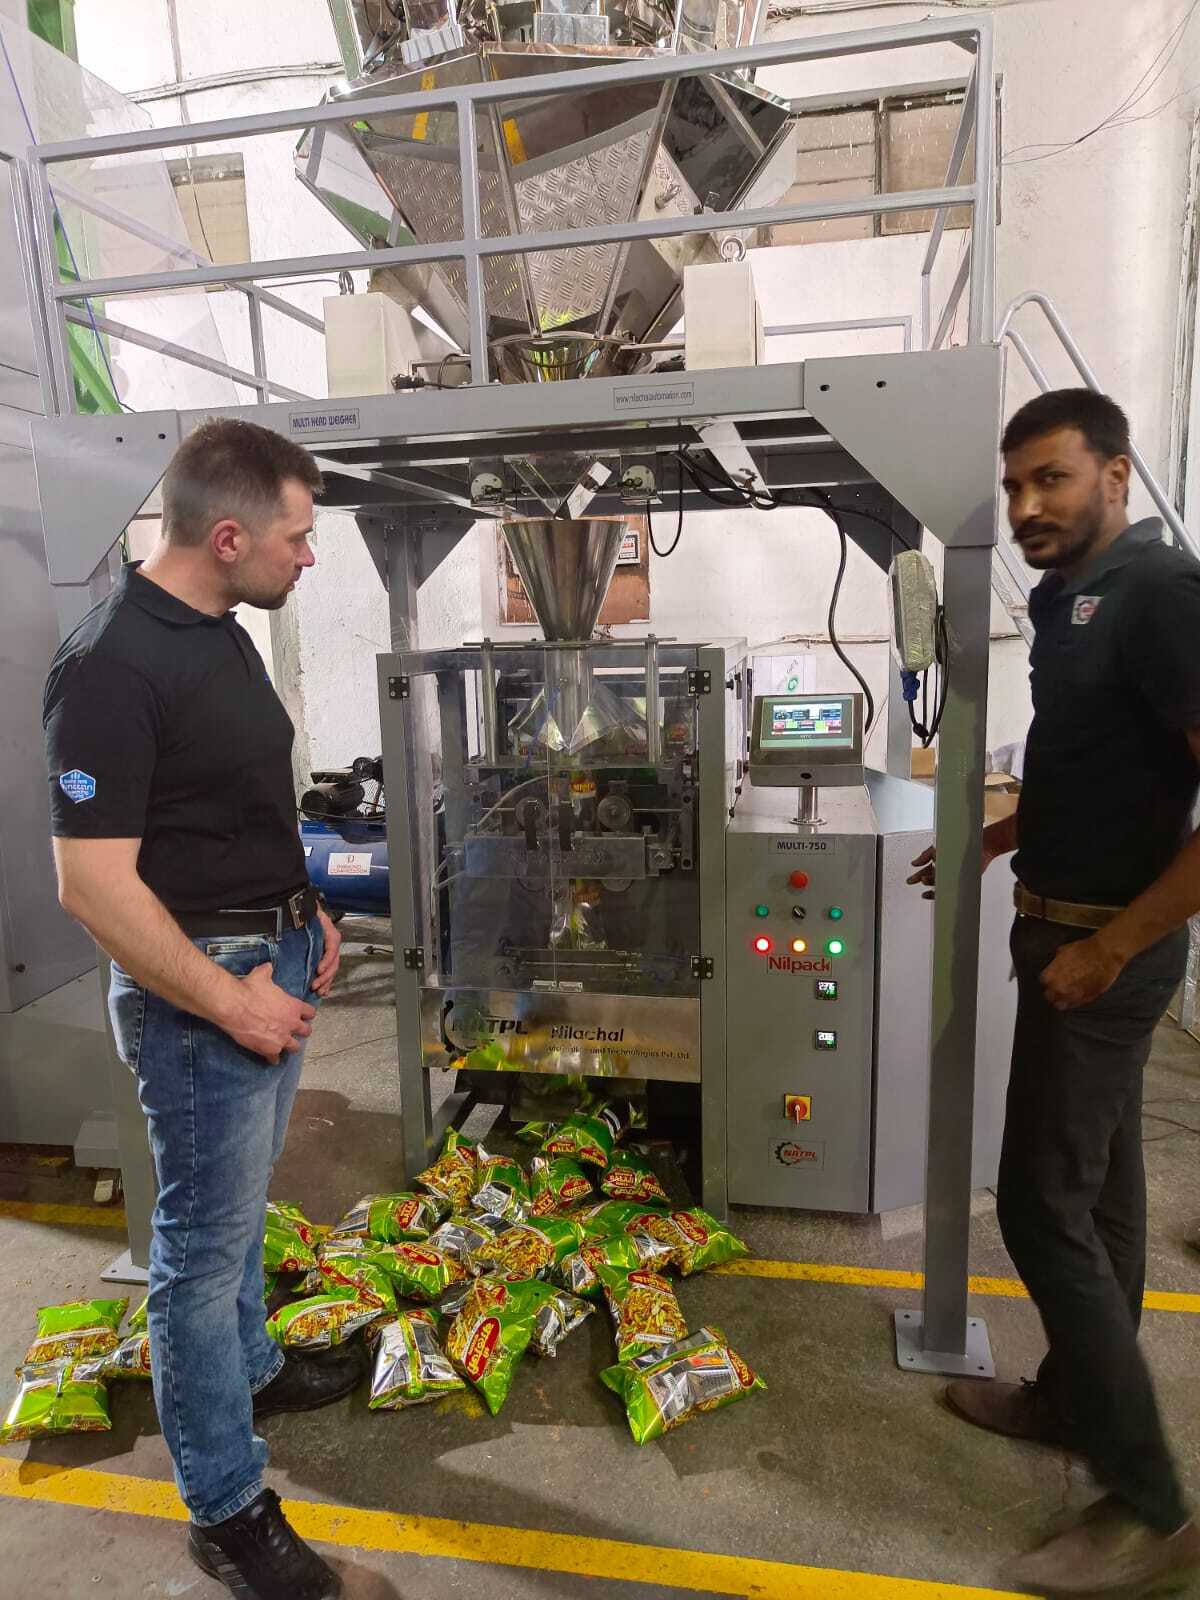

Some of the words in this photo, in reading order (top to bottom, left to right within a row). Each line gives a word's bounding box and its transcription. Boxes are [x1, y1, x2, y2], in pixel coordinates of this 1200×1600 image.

[777, 841, 827, 850] MULTI-750
[768, 956, 831, 974] Nilpack
[551, 1025, 624, 1042] Nilachal
